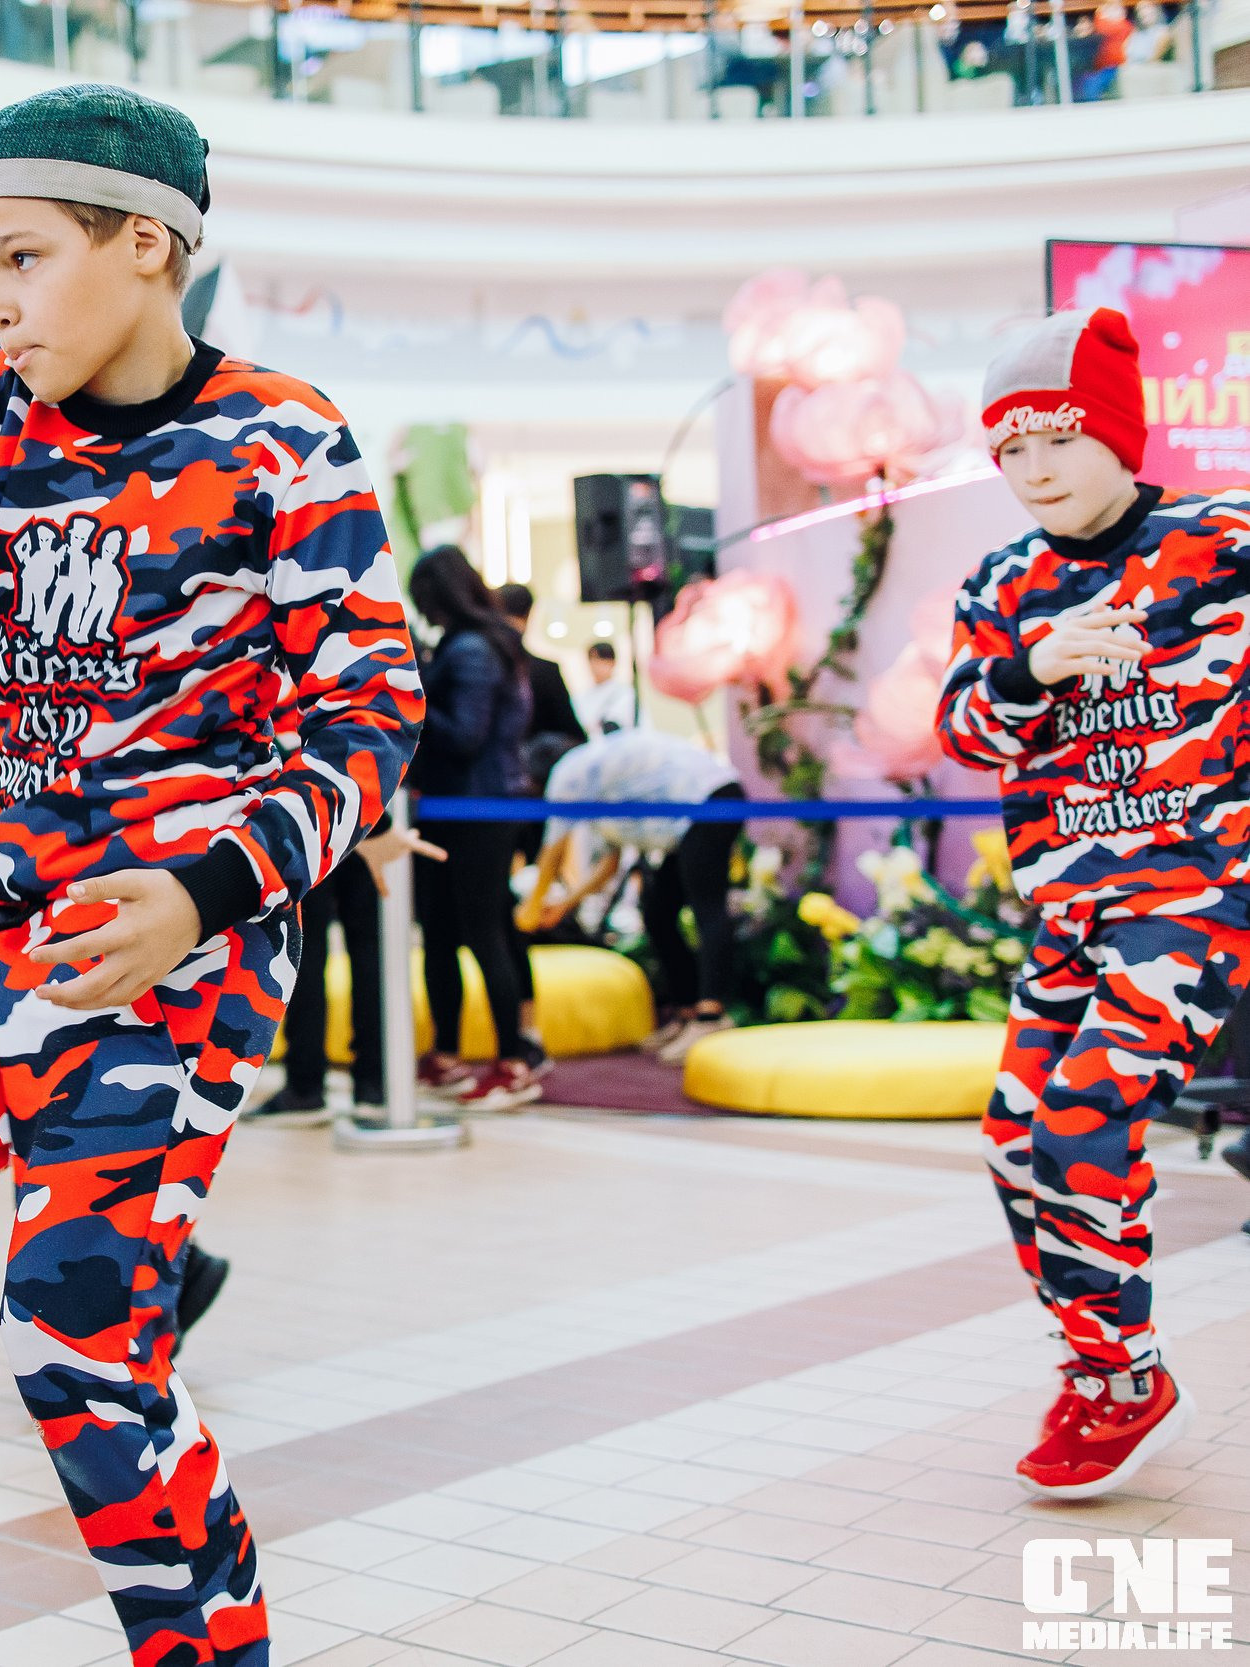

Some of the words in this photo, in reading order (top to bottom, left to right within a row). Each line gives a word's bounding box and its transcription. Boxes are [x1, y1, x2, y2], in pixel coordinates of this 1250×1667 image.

[18, 696, 88, 756] city
[1054, 685, 1179, 742] Köenig
[1086, 743, 1143, 786] city
